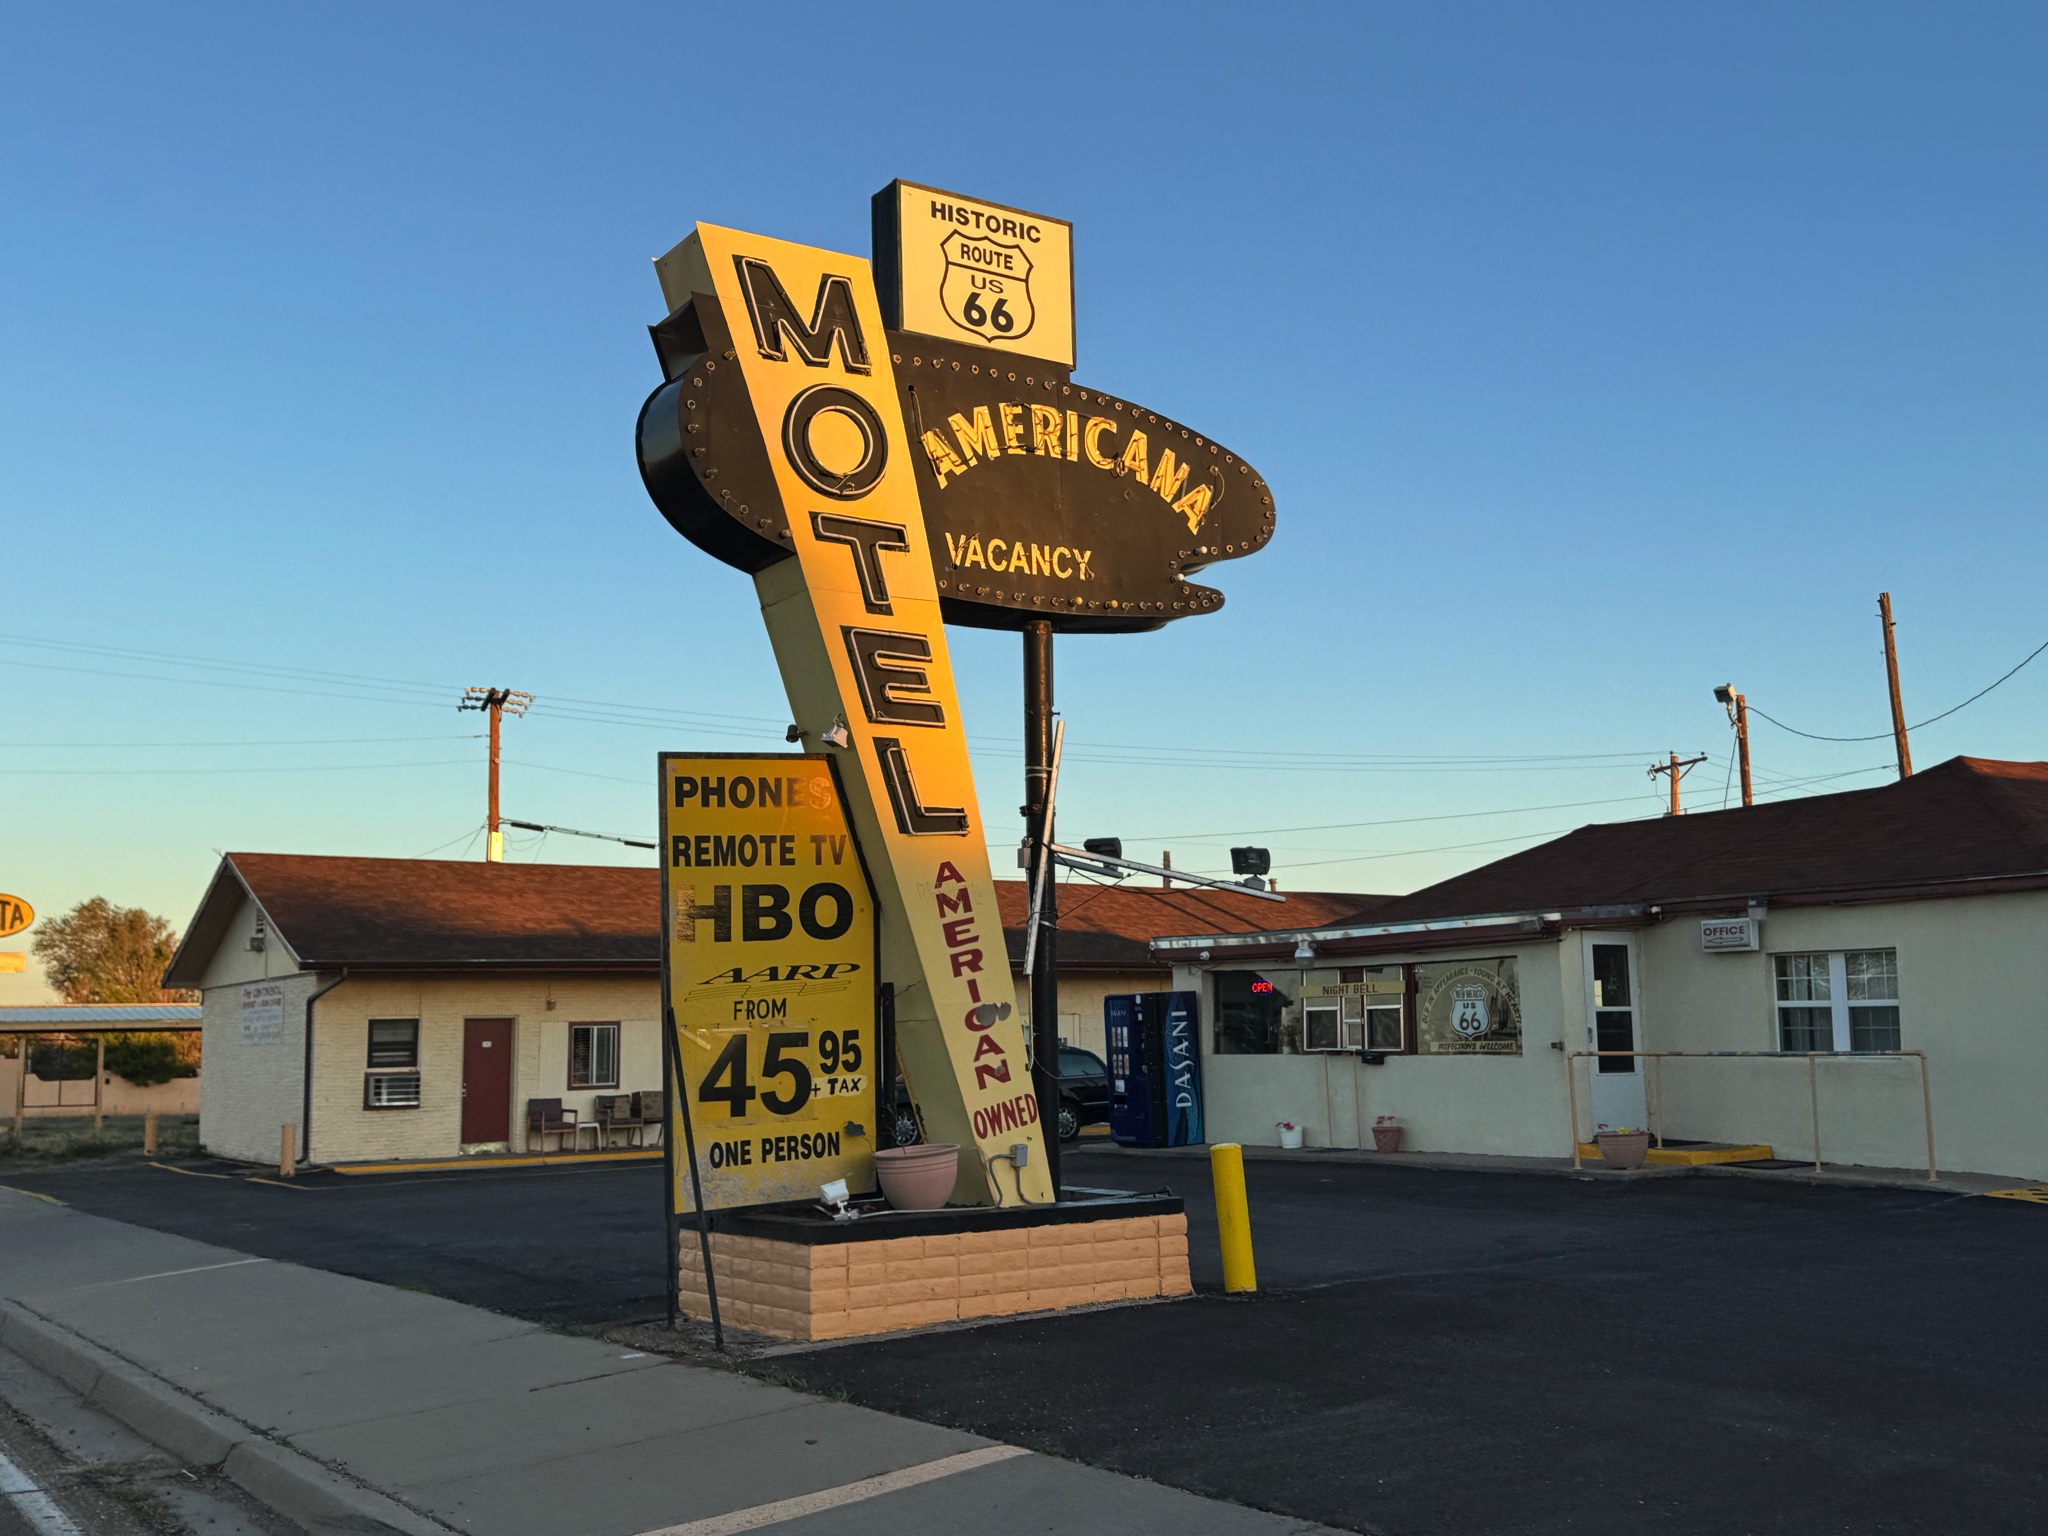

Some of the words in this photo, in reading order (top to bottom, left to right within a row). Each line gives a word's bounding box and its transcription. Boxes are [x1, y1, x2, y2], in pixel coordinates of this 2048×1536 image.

[930, 200, 1041, 244] HISTORIC
[960, 243, 1014, 271] ROUTE
[970, 274, 1004, 294] US
[963, 291, 1014, 333] 66
[921, 402, 1214, 536] AMERICANA
[731, 254, 971, 837] MOTEL
[945, 532, 1092, 580] VACANCY
[674, 776, 832, 810] PHONES
[672, 834, 796, 867] REMOTE
[810, 834, 847, 865] TV
[676, 882, 854, 944] HBO
[1703, 926, 1745, 936] OFFICE
[697, 962, 861, 986] AARP
[934, 860, 1012, 1091] AMERICAN
[1251, 982, 1273, 993] OPEN
[1322, 985, 1349, 995] NIGHT
[1353, 984, 1379, 994] BELL
[1474, 967, 1496, 983] YOUNG
[733, 998, 787, 1021] FROM
[1459, 1011, 1482, 1031] 66
[1169, 1010, 1195, 1108] DASANI
[1479, 1042, 1515, 1051] WELCOME
[698, 1031, 812, 1117] 45
[818, 1029, 862, 1075] 95
[827, 1077, 862, 1096] TAX
[973, 1093, 1038, 1140] OWNED
[709, 1140, 752, 1169] ONE
[761, 1131, 841, 1164] PERSON
